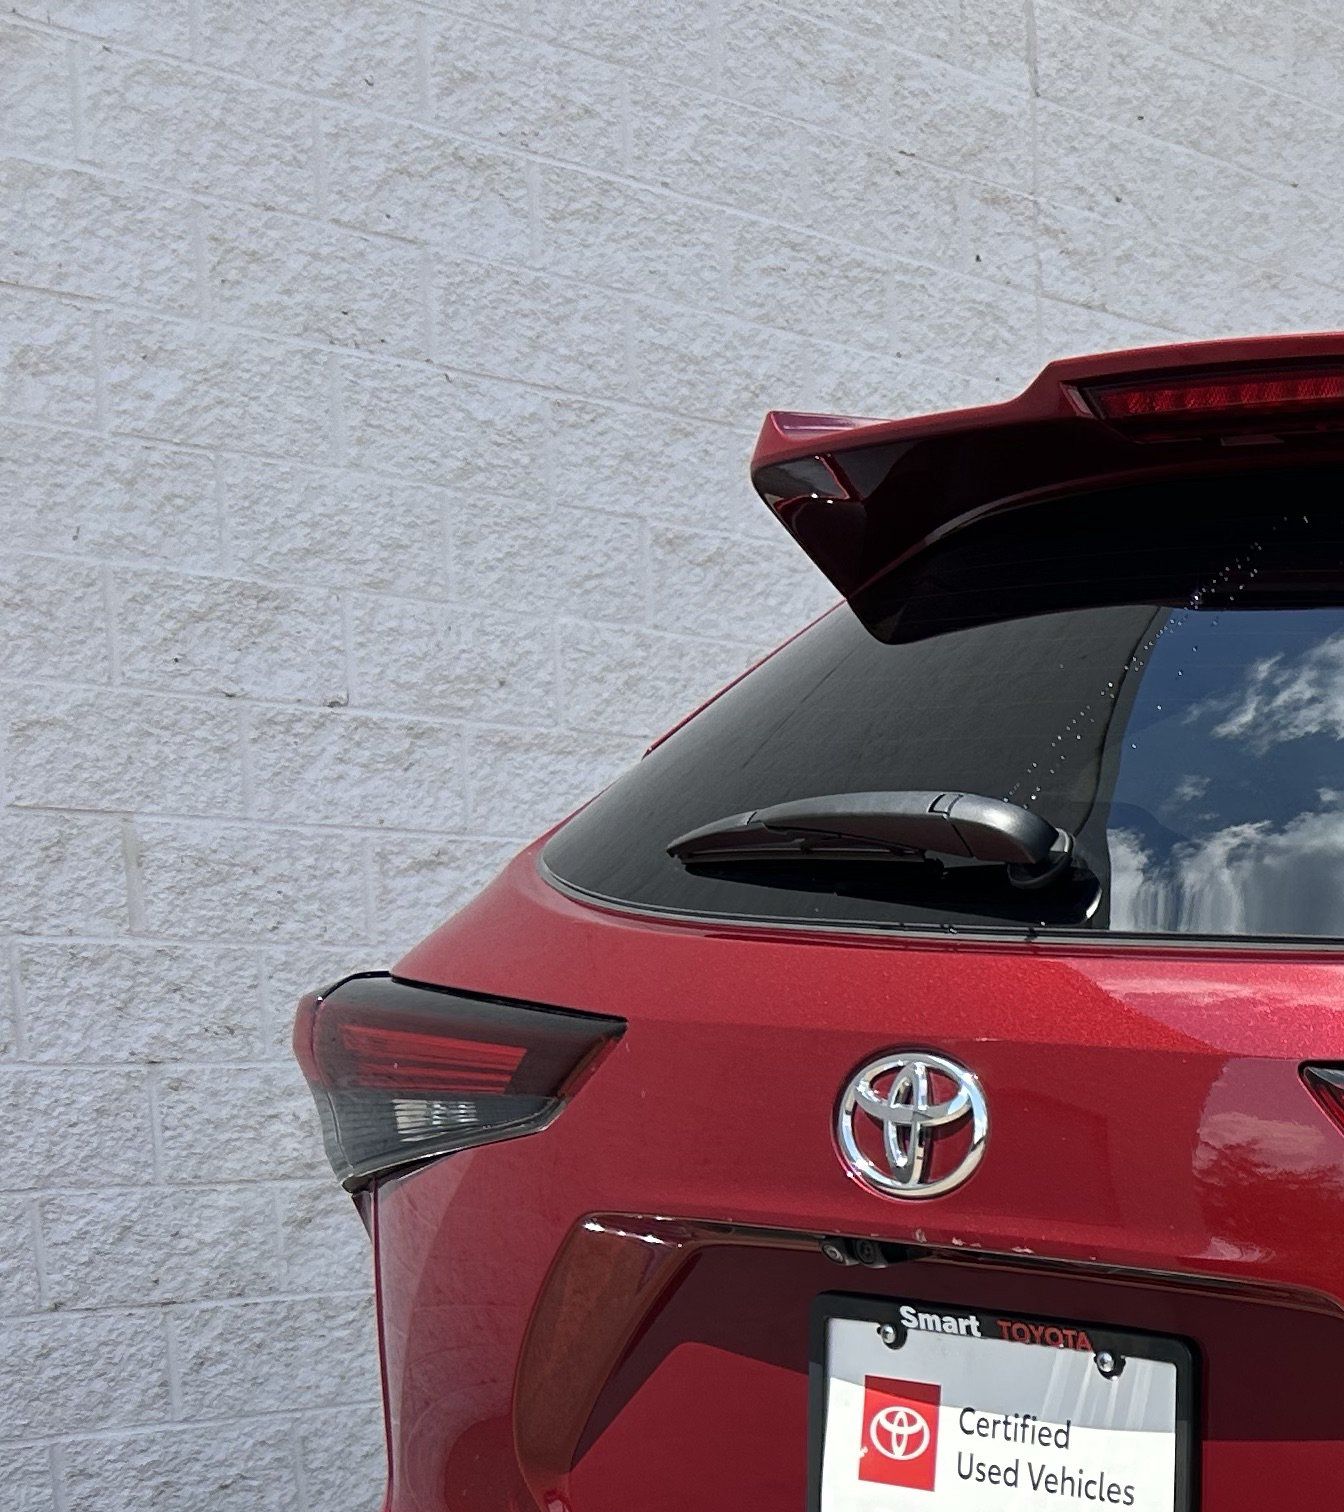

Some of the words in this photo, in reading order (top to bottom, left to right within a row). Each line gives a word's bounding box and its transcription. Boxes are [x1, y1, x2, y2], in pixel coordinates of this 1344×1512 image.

[900, 1305, 981, 1338] Smart
[996, 1320, 1093, 1352] TOYOTA
[958, 1406, 1071, 1449] Certified
[957, 1451, 1019, 1488] Used
[1027, 1461, 1135, 1506] Vehicles
